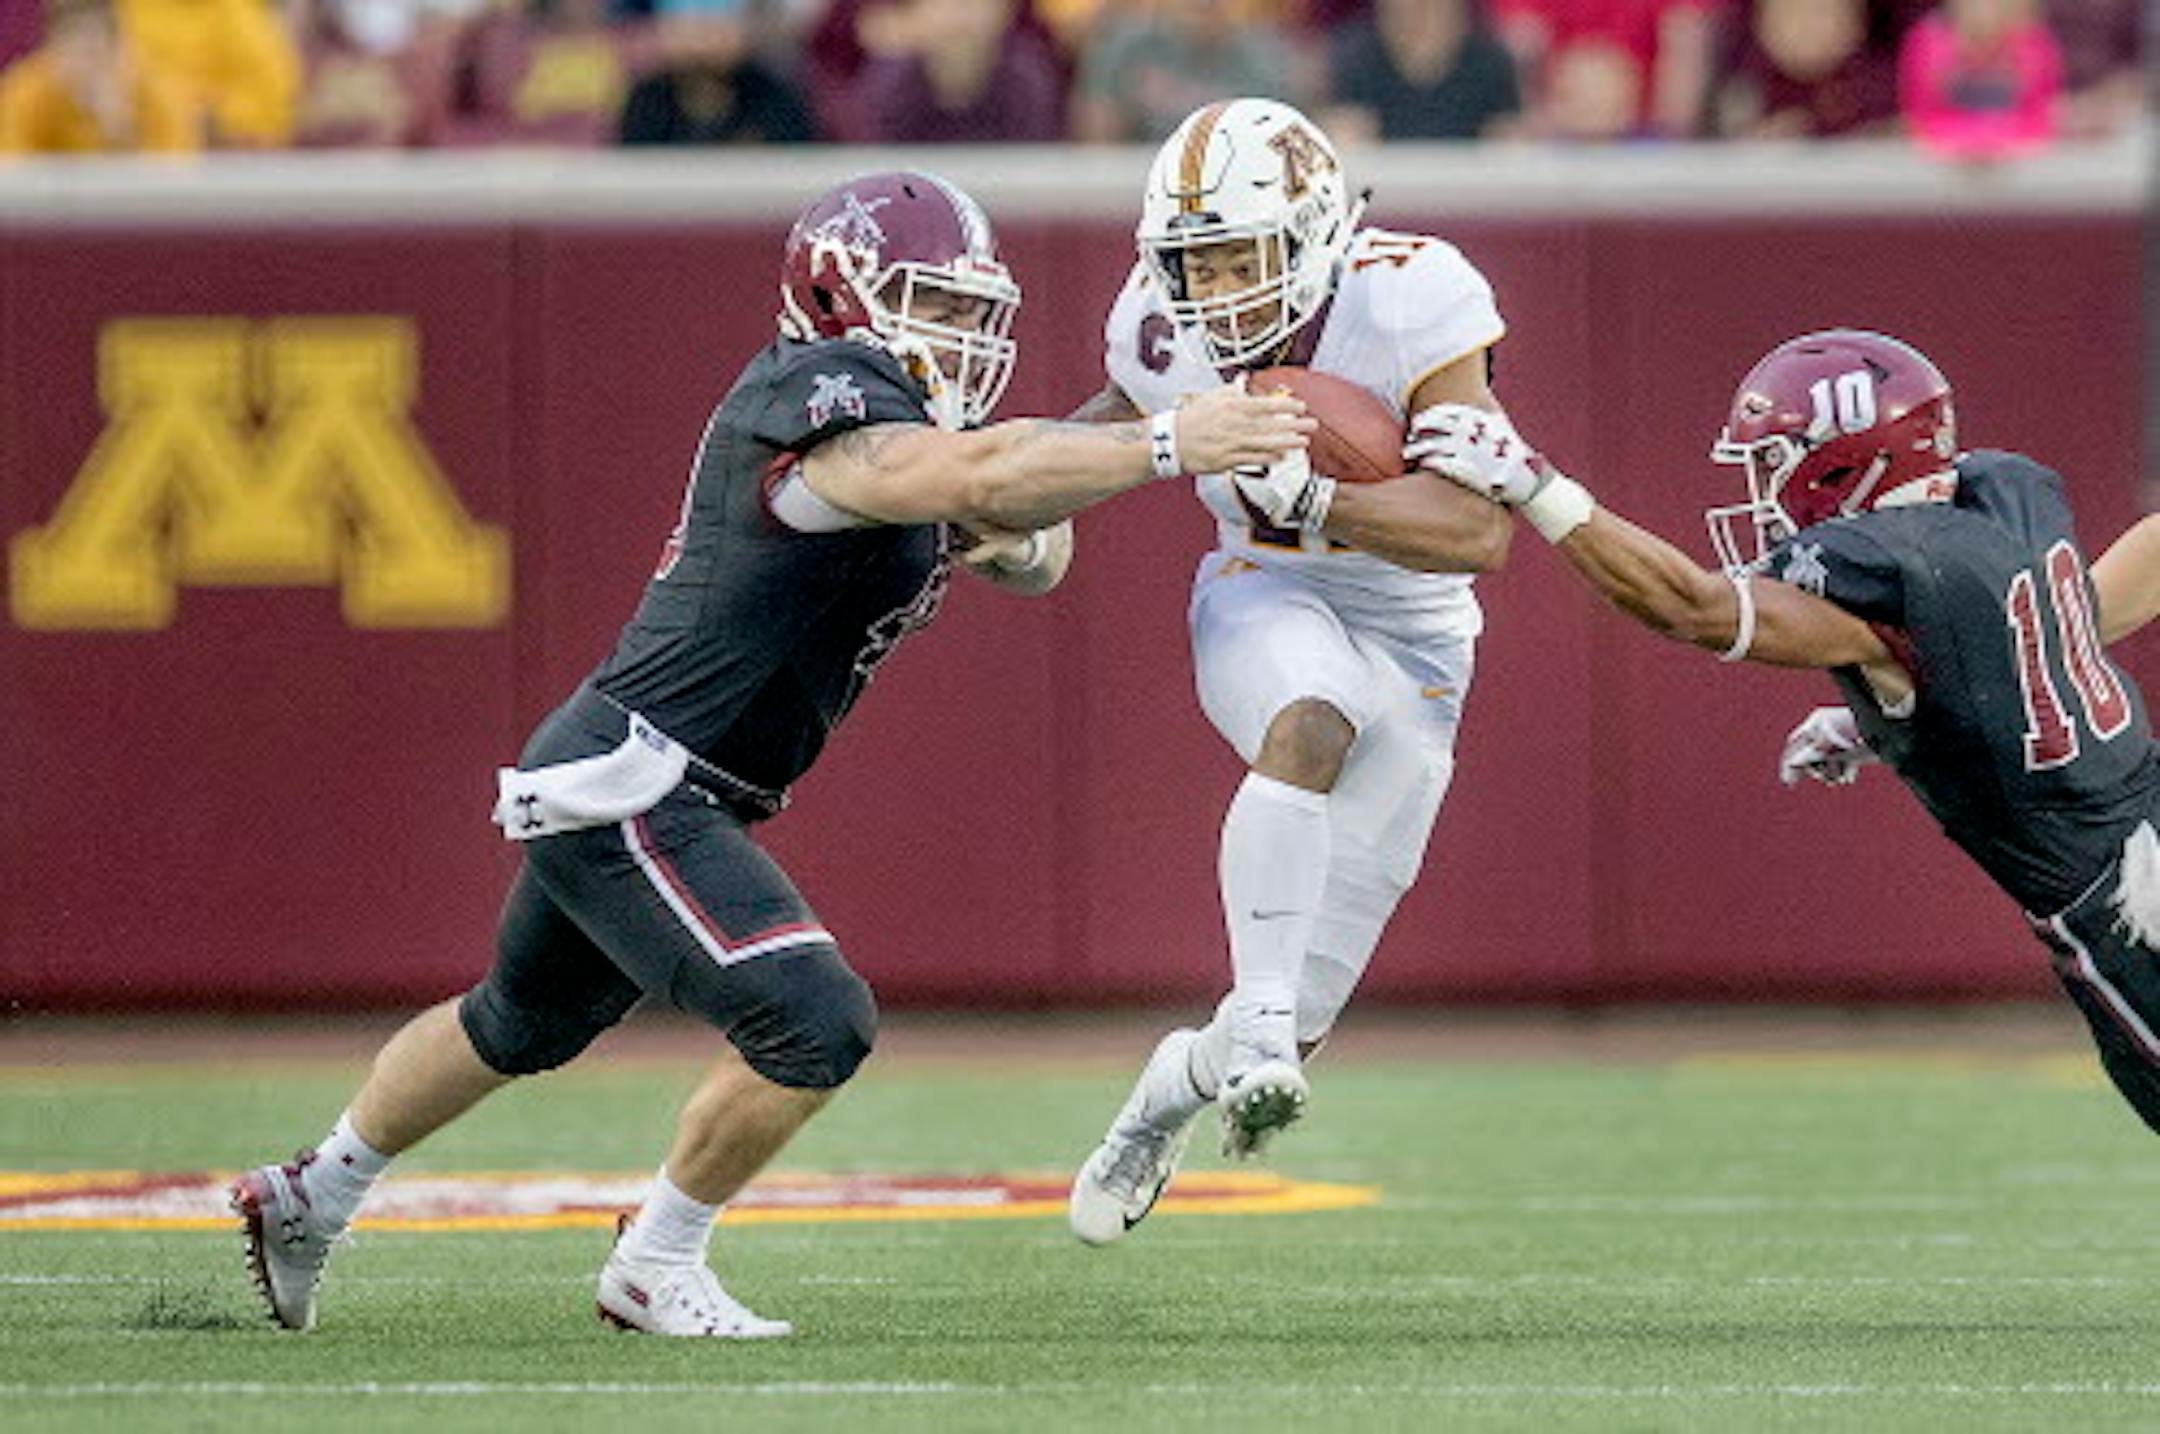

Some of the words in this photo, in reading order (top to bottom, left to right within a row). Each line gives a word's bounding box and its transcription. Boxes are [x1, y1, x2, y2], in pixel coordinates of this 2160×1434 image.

[1137, 312, 1176, 375] C
[1808, 369, 1877, 441] 10
[9, 316, 513, 632] M
[2007, 538, 2132, 774] 10
